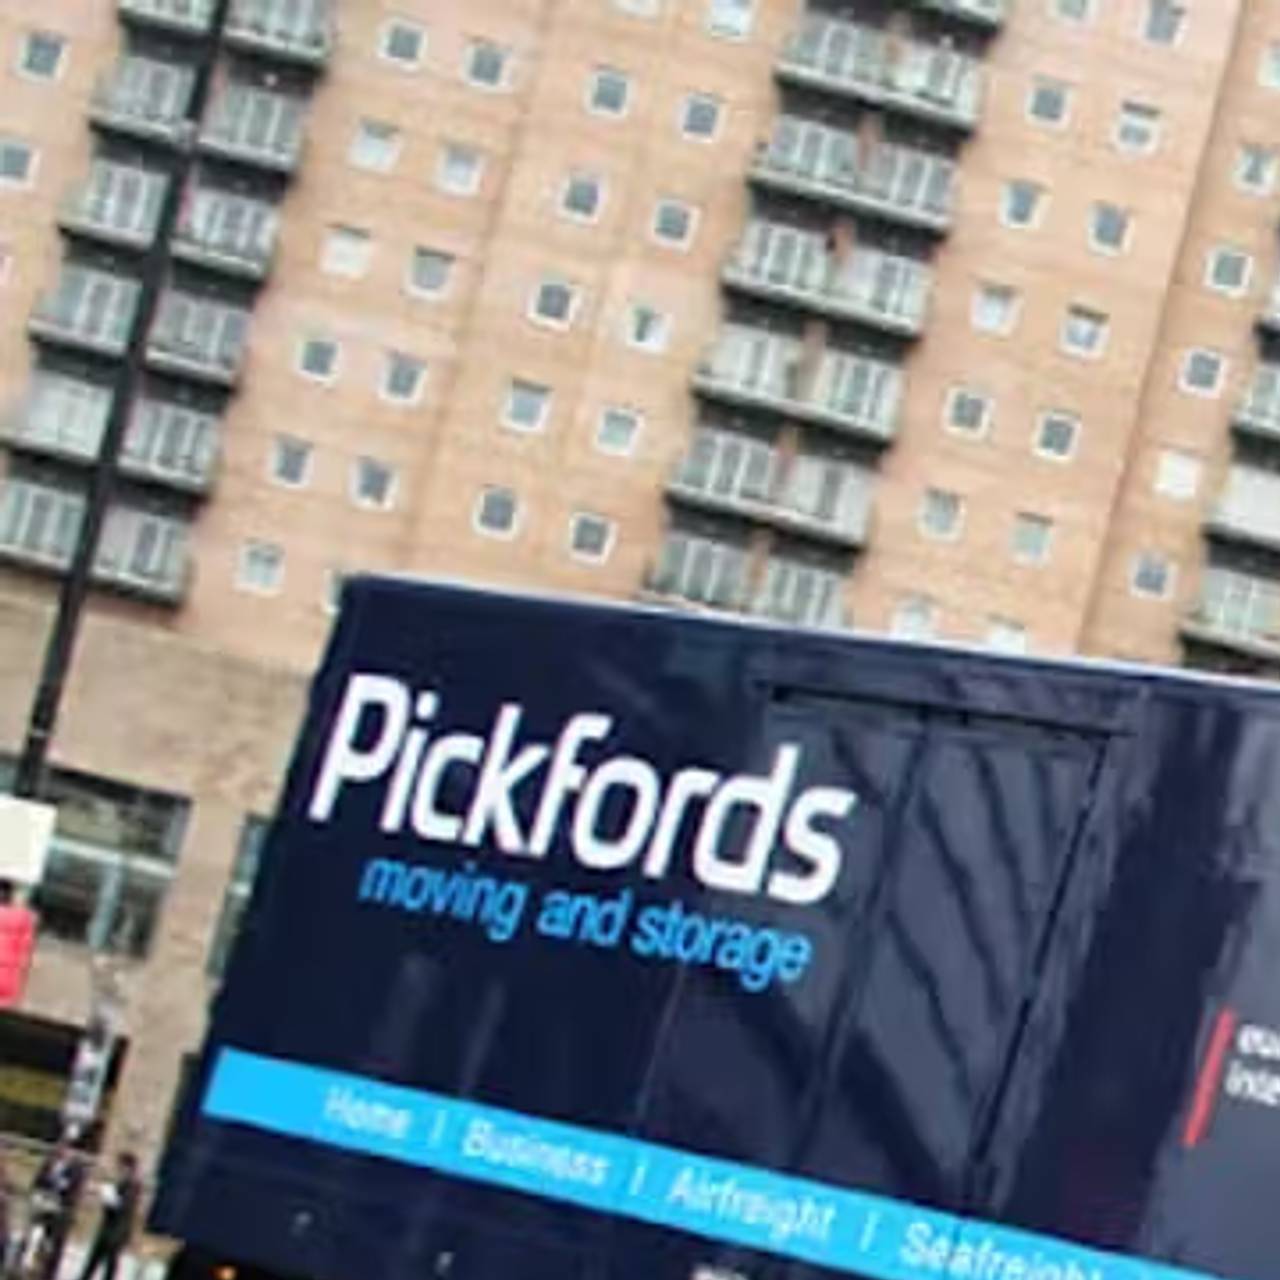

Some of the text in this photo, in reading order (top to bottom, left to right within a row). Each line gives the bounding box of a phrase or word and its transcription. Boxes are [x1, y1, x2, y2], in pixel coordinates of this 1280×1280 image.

[308, 673, 857, 904] Pickfords
[359, 858, 812, 991] moving and storage
[323, 1085, 411, 1141] Home
[462, 1117, 611, 1187] Business
[667, 1167, 838, 1241] Airfreight
